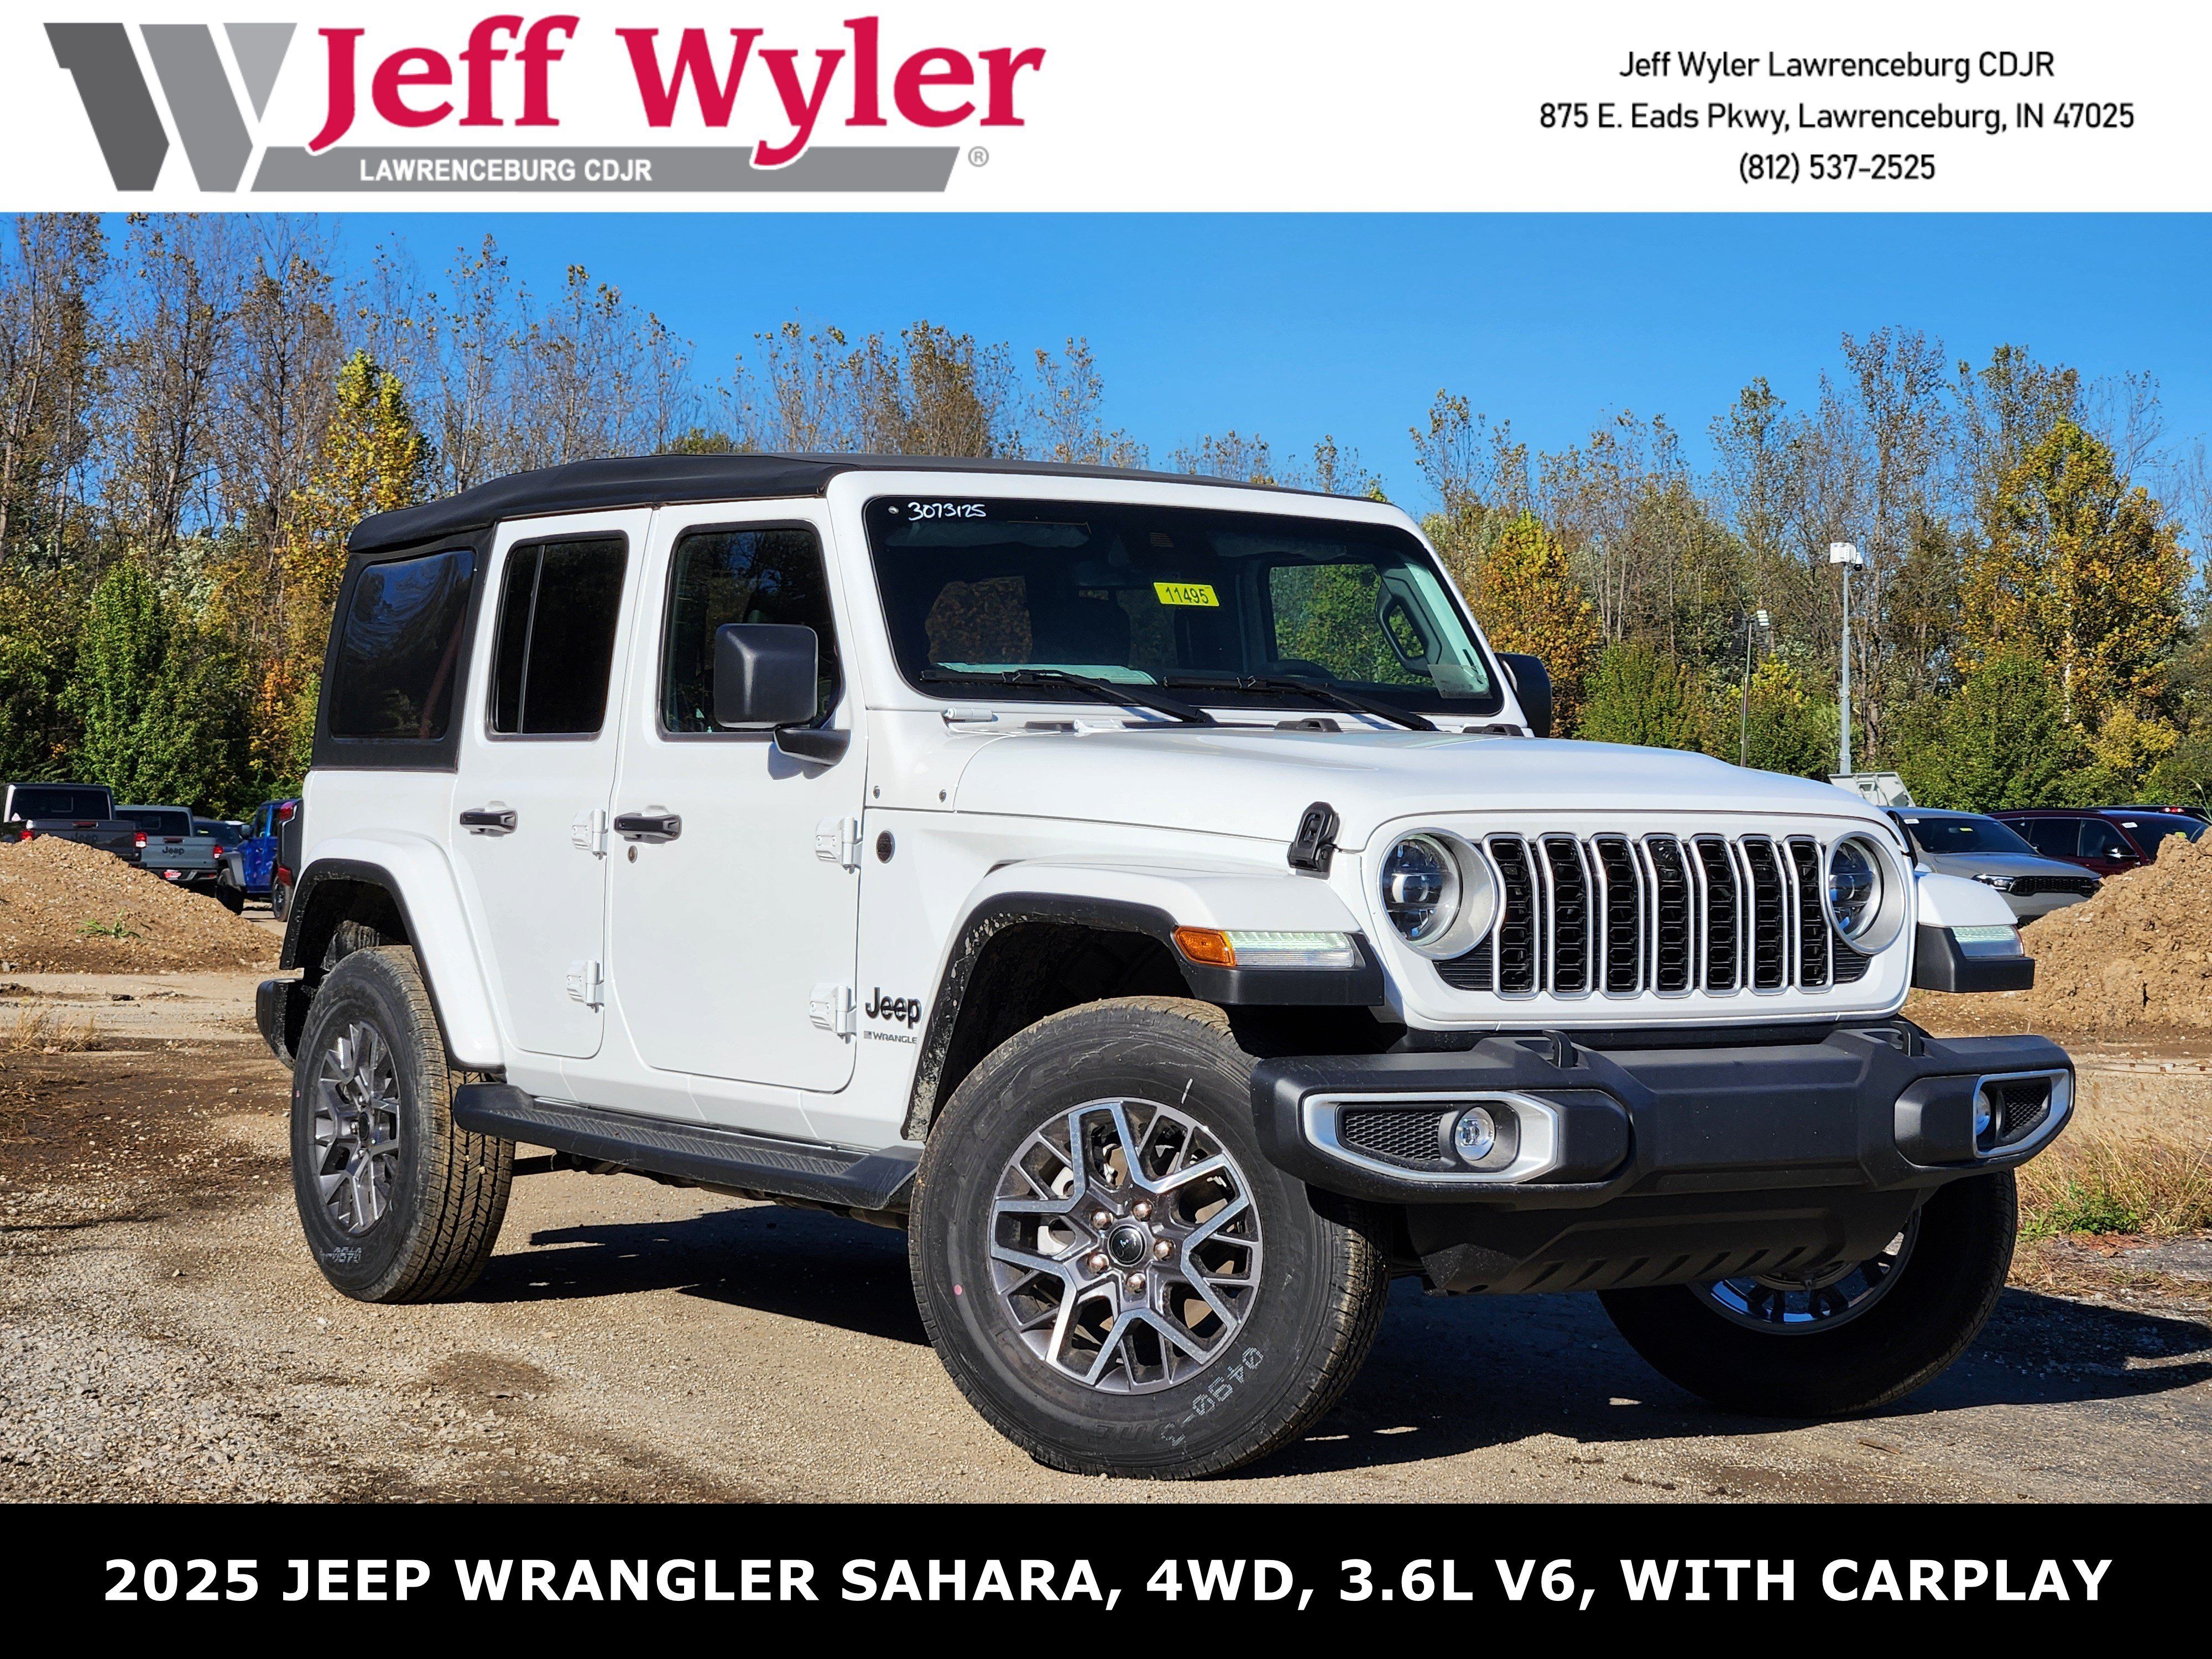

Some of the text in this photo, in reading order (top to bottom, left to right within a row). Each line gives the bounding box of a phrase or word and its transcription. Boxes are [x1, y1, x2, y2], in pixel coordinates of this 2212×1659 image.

[907, 502, 987, 521] 3073125
[1166, 586, 1209, 604] 11495
[162, 846, 185, 855] Jeep
[865, 987, 922, 1030] Jeep
